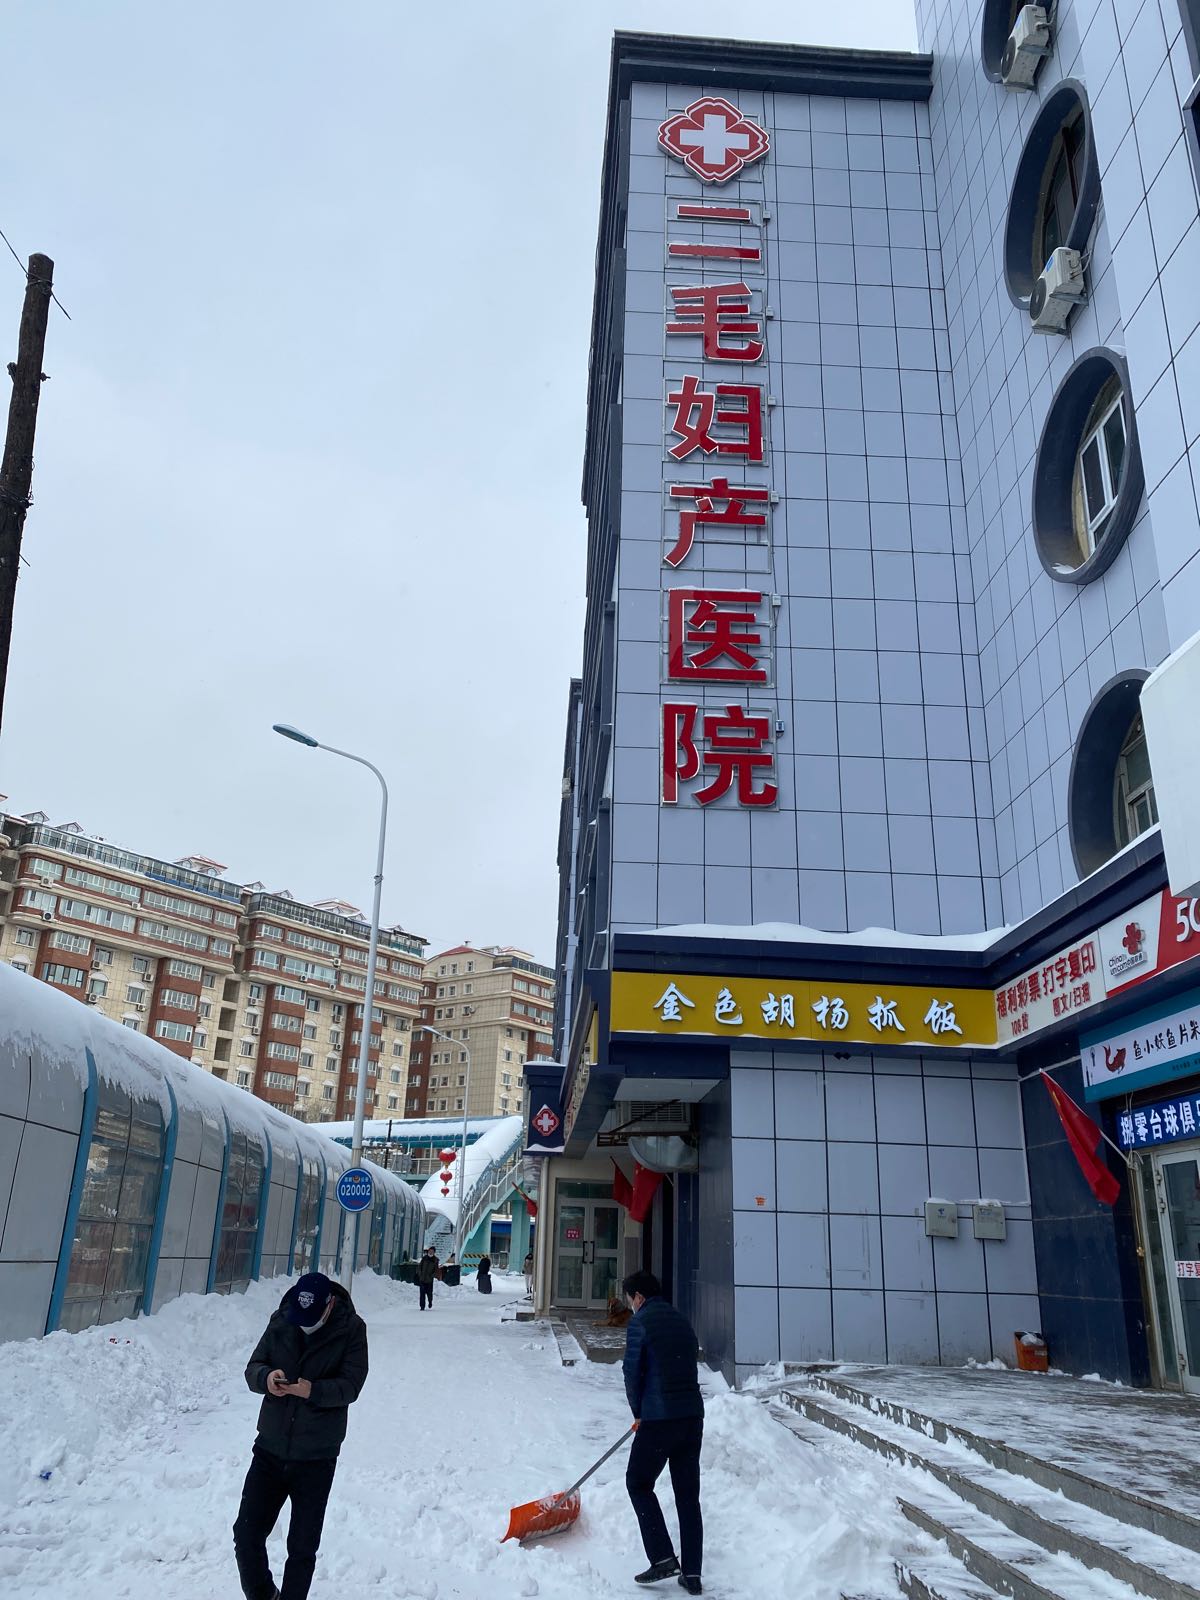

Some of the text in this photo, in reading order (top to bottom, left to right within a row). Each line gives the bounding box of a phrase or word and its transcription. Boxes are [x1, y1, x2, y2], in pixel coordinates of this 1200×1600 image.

[661, 204, 779, 807] 二毛妇产医院
[996, 941, 1097, 1020] 福利彩票 打字复印
[653, 981, 963, 1035] 金色胡杨抓饭
[1120, 1099, 1200, 1145] 捌零台球俱
[340, 1184, 371, 1196] 020002
